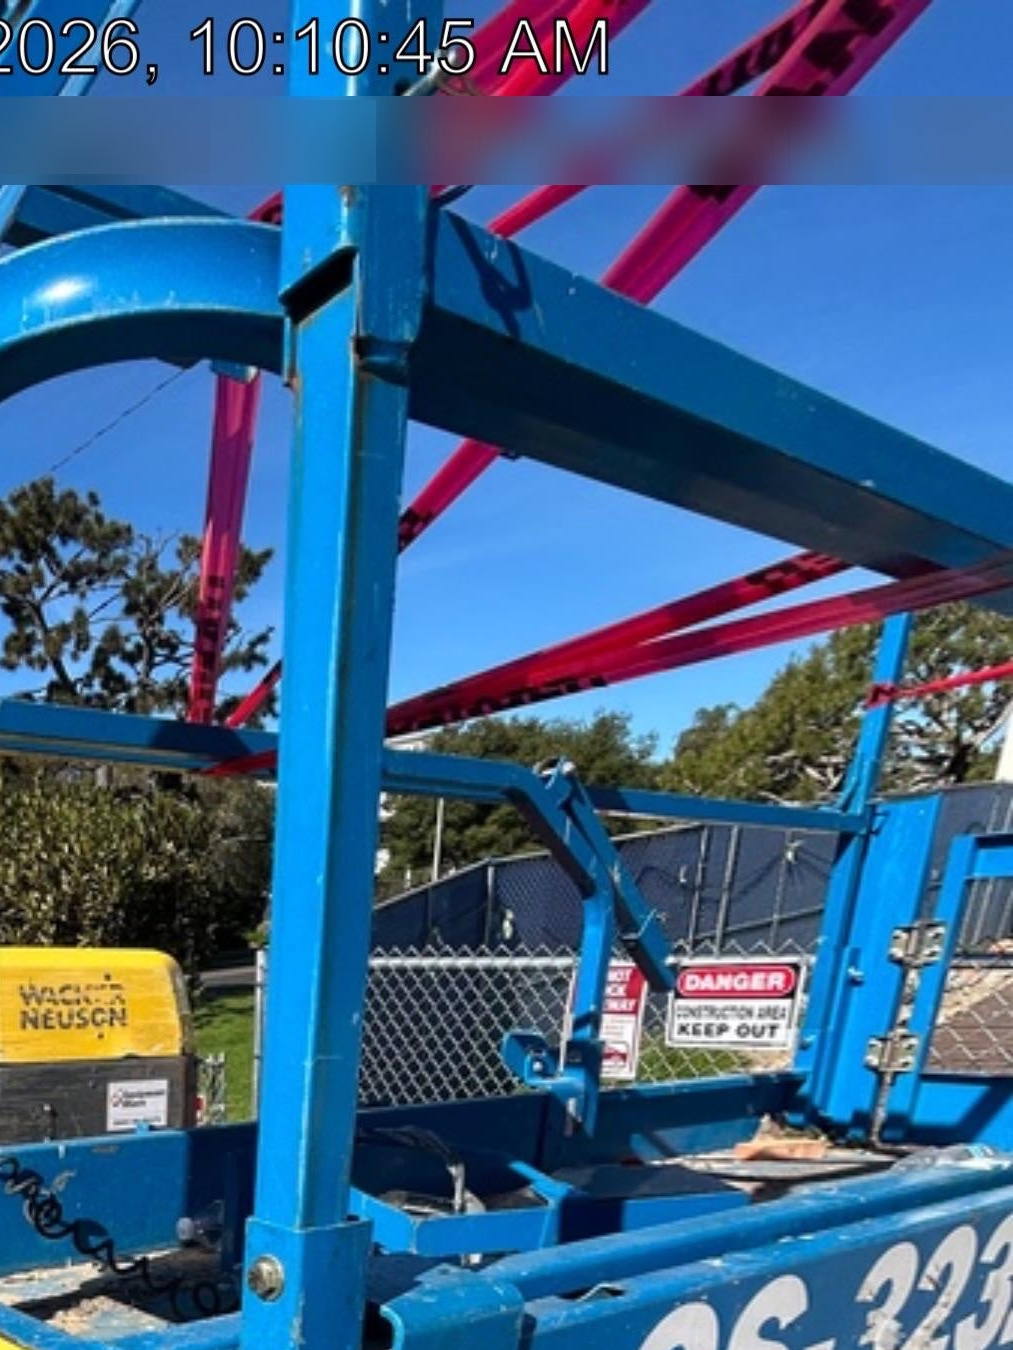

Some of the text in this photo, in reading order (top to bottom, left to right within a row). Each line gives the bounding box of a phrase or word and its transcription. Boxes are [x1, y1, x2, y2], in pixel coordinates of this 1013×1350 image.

[683, 971, 787, 992] DANGER
[19, 1007, 128, 1030] NEUSON
[677, 1022, 780, 1039] KEEP OUT
